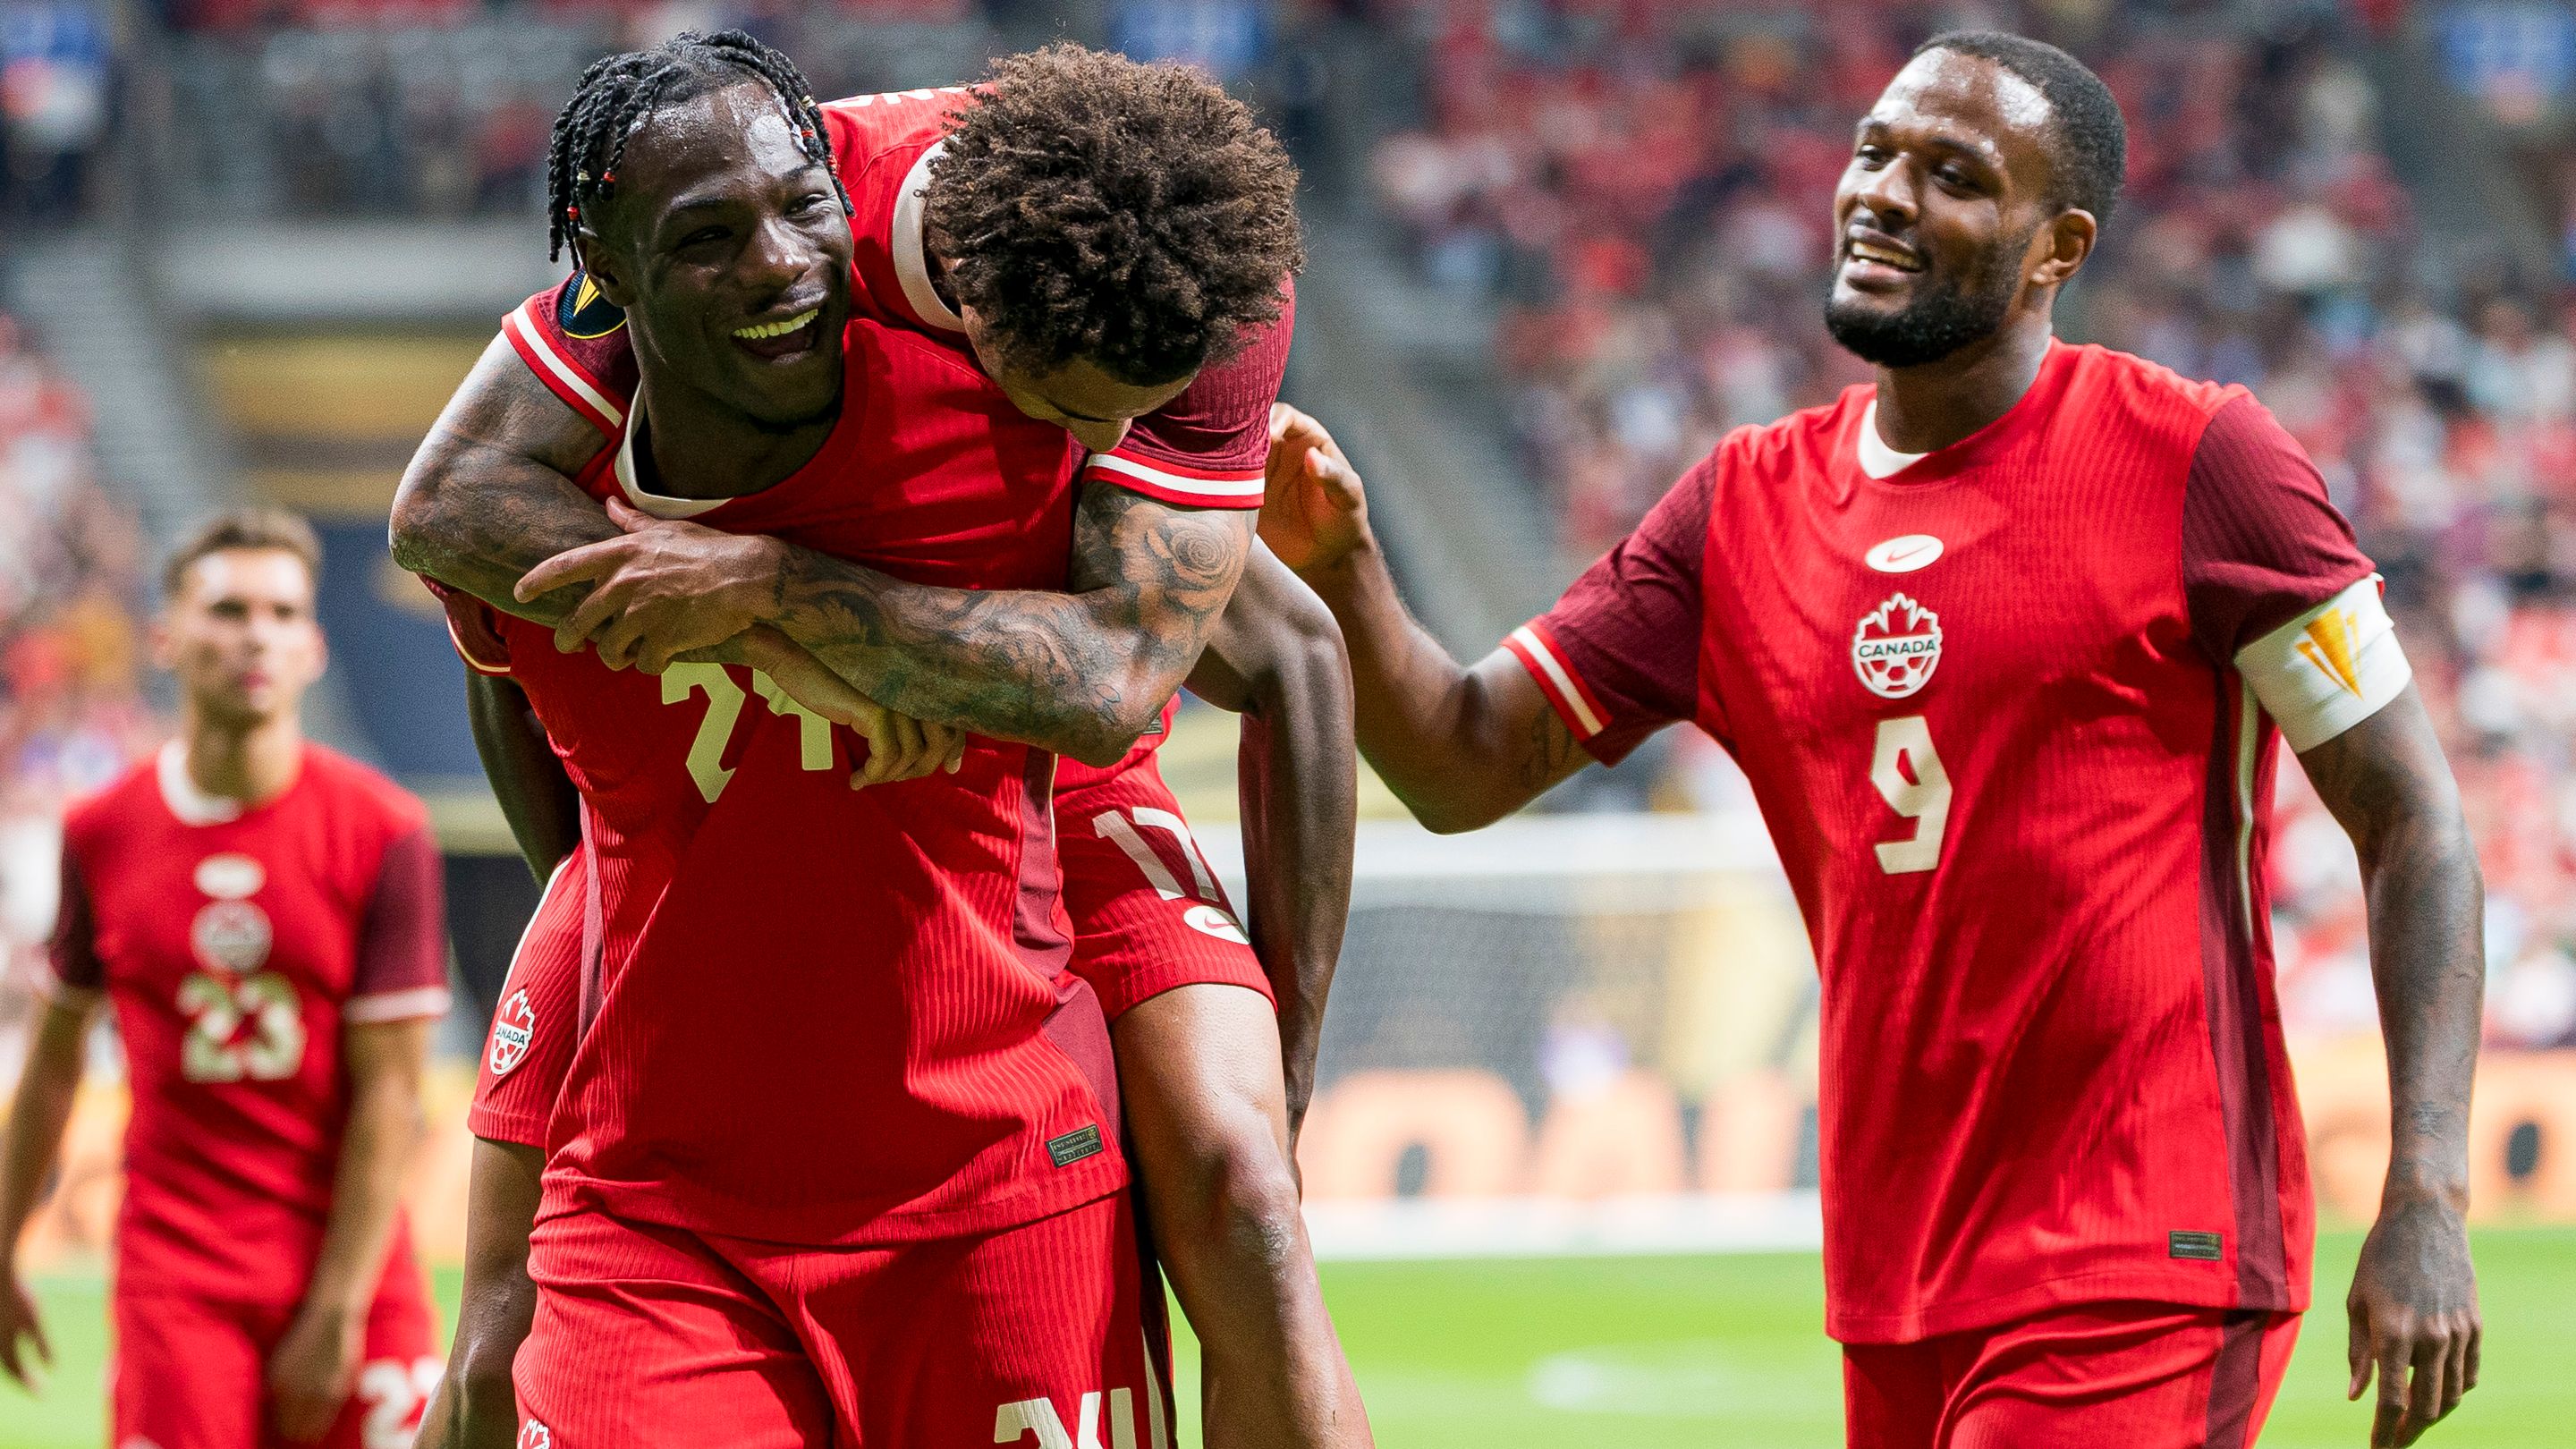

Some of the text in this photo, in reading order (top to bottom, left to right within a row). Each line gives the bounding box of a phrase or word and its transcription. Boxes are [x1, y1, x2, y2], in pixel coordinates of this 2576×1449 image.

[1859, 640, 1936, 657] CANADA
[1870, 716, 1953, 874] 9
[1092, 806, 1220, 901] 17
[176, 973, 307, 1082] 23
